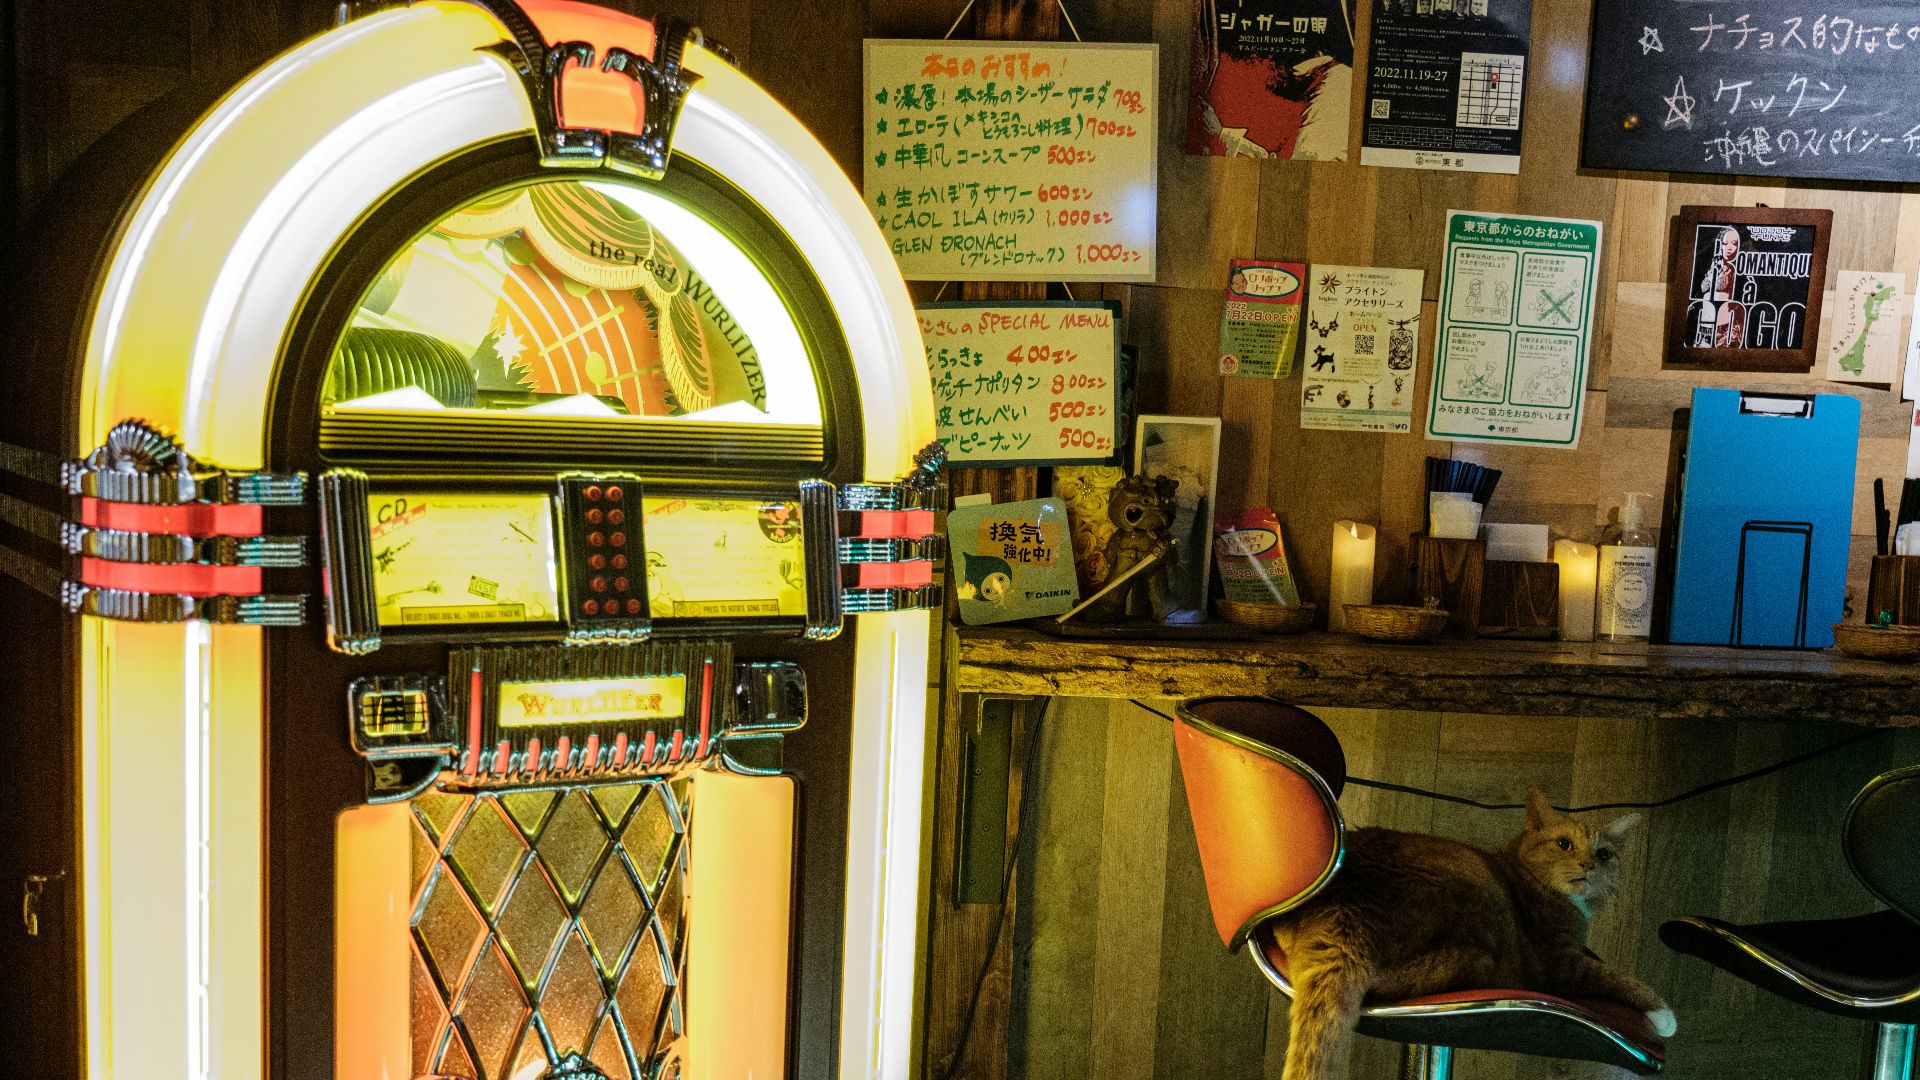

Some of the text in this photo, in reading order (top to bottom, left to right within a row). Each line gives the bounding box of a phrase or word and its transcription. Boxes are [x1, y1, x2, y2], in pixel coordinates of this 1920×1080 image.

[1220, 12, 1328, 34] ジャガーの眼
[1374, 66, 1448, 82] 2022.11.19-27
[891, 210, 943, 231] CAOL
[953, 206, 988, 227] ILA
[1463, 221, 1584, 241] 東京都からのおねがい
[1455, 233, 1480, 242] Requests
[1522, 239, 1556, 248] Metropolitan
[1557, 242, 1590, 250] Government
[1345, 286, 1388, 297] ブライトン
[1345, 298, 1404, 309] アクセサリーズ
[590, 239, 768, 404] the real WURLITZER
[979, 311, 1050, 336] SPECIAL
[1059, 313, 1110, 331] MENU
[1264, 312, 1298, 323] OPEN
[1353, 324, 1377, 333] OPEN
[1438, 404, 1572, 421] みなさまのご協力をおねがいします
[378, 498, 407, 525] CD
[990, 521, 1045, 545] 換気
[1003, 545, 1051, 562] 強化中!
[1035, 589, 1072, 599] DAIKIN
[703, 605, 720, 613] PRESS
[720, 605, 728, 613] TO
[747, 604, 760, 612] SONG
